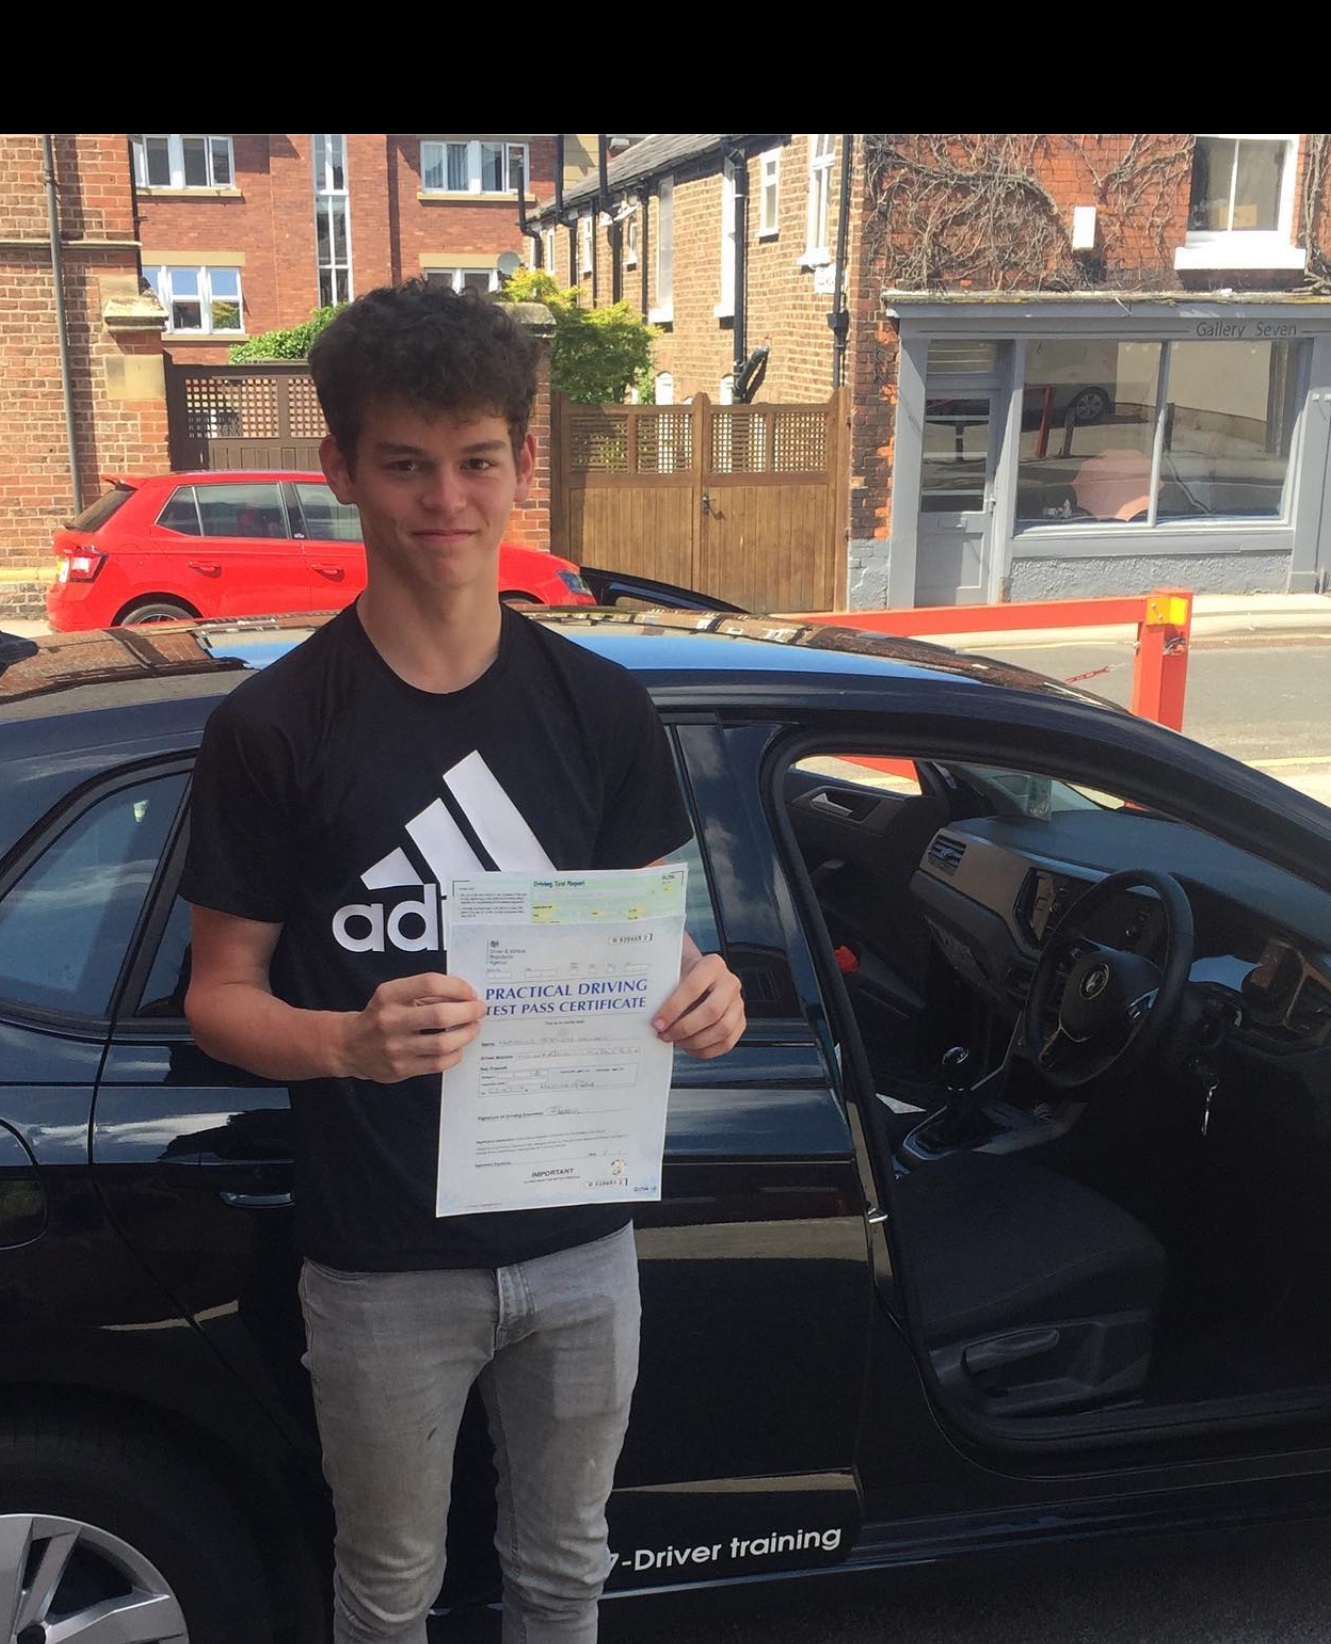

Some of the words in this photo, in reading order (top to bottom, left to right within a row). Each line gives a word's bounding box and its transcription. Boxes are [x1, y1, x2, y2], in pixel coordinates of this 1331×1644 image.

[1195, 321, 1246, 338] Gallery
[1256, 321, 1297, 337] Seven
[485, 984, 573, 1001] PRACTICAL
[577, 978, 648, 996] DRIVING
[521, 1002, 555, 1014] PASS
[559, 996, 647, 1013] CERTIFICATE
[729, 1527, 842, 1559] training
